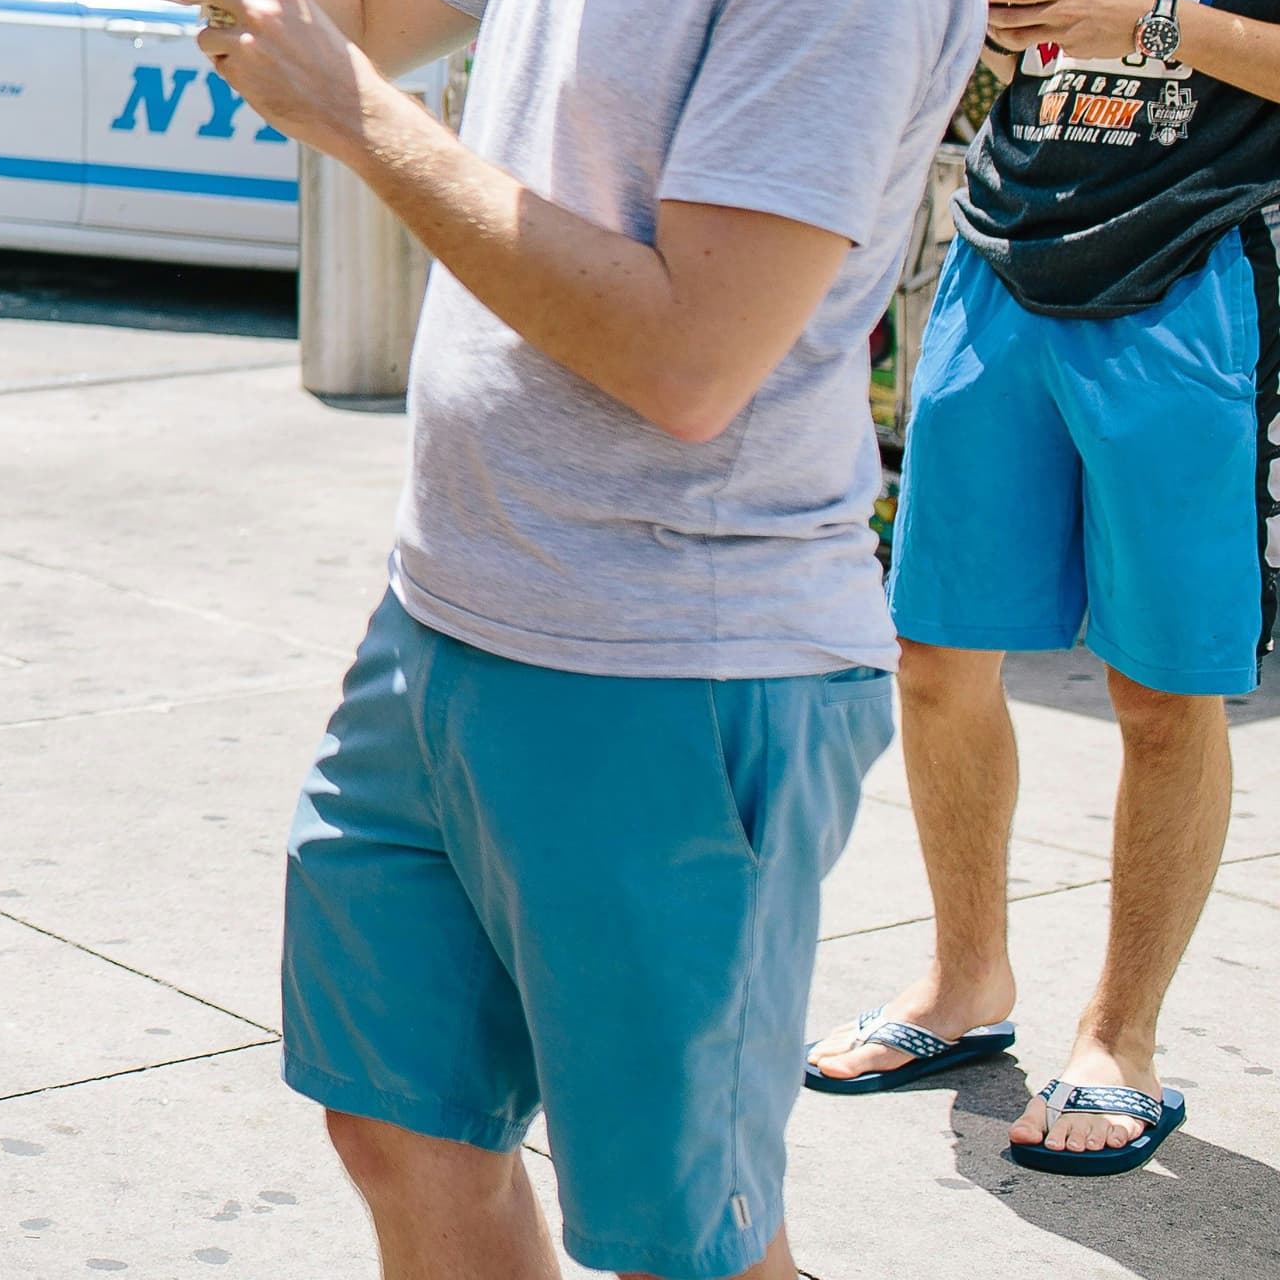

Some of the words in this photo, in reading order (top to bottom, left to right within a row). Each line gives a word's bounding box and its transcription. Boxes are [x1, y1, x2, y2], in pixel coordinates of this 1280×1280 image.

[111, 66, 288, 142] NY
[1070, 93, 1144, 129] YORK
[1063, 126, 1101, 144] FINAL
[1101, 129, 1138, 147] FOUR
